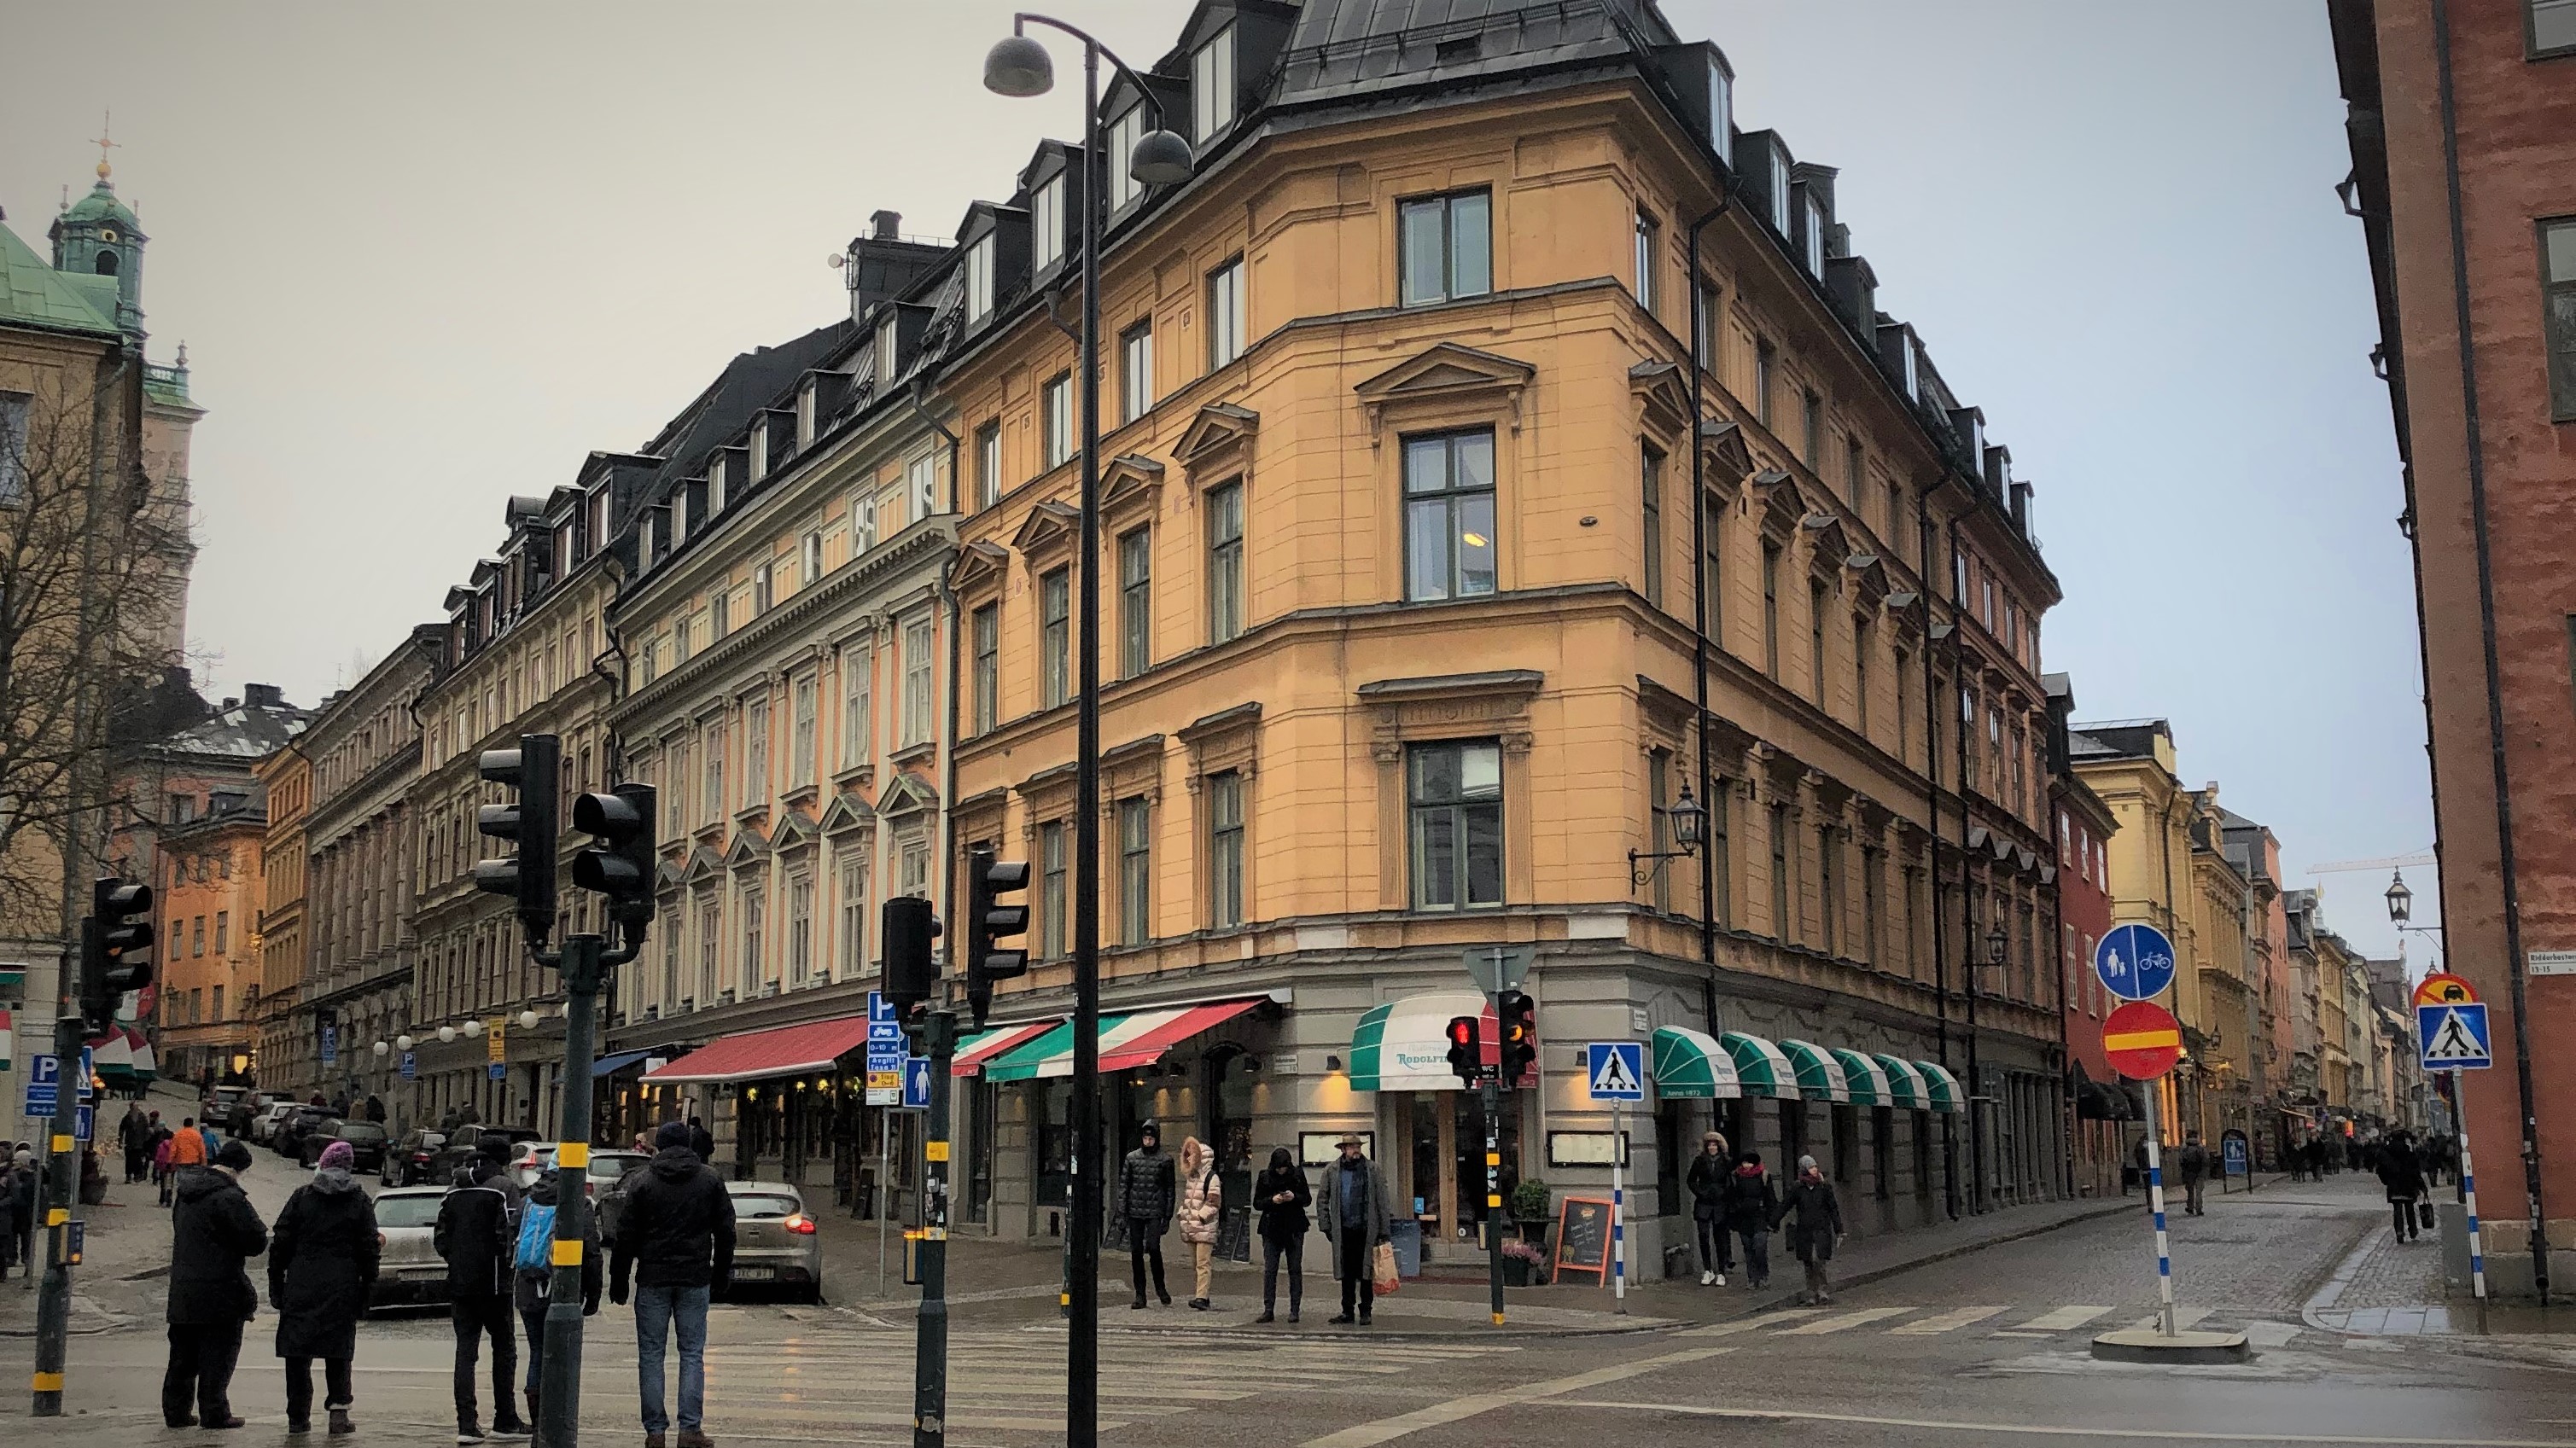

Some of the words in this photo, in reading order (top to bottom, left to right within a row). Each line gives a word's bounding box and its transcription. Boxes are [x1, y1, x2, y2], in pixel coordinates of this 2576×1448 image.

[405, 1054, 413, 1064] P
[1396, 1054, 1448, 1070] RODOLFI
[39, 1056, 59, 1081] P
